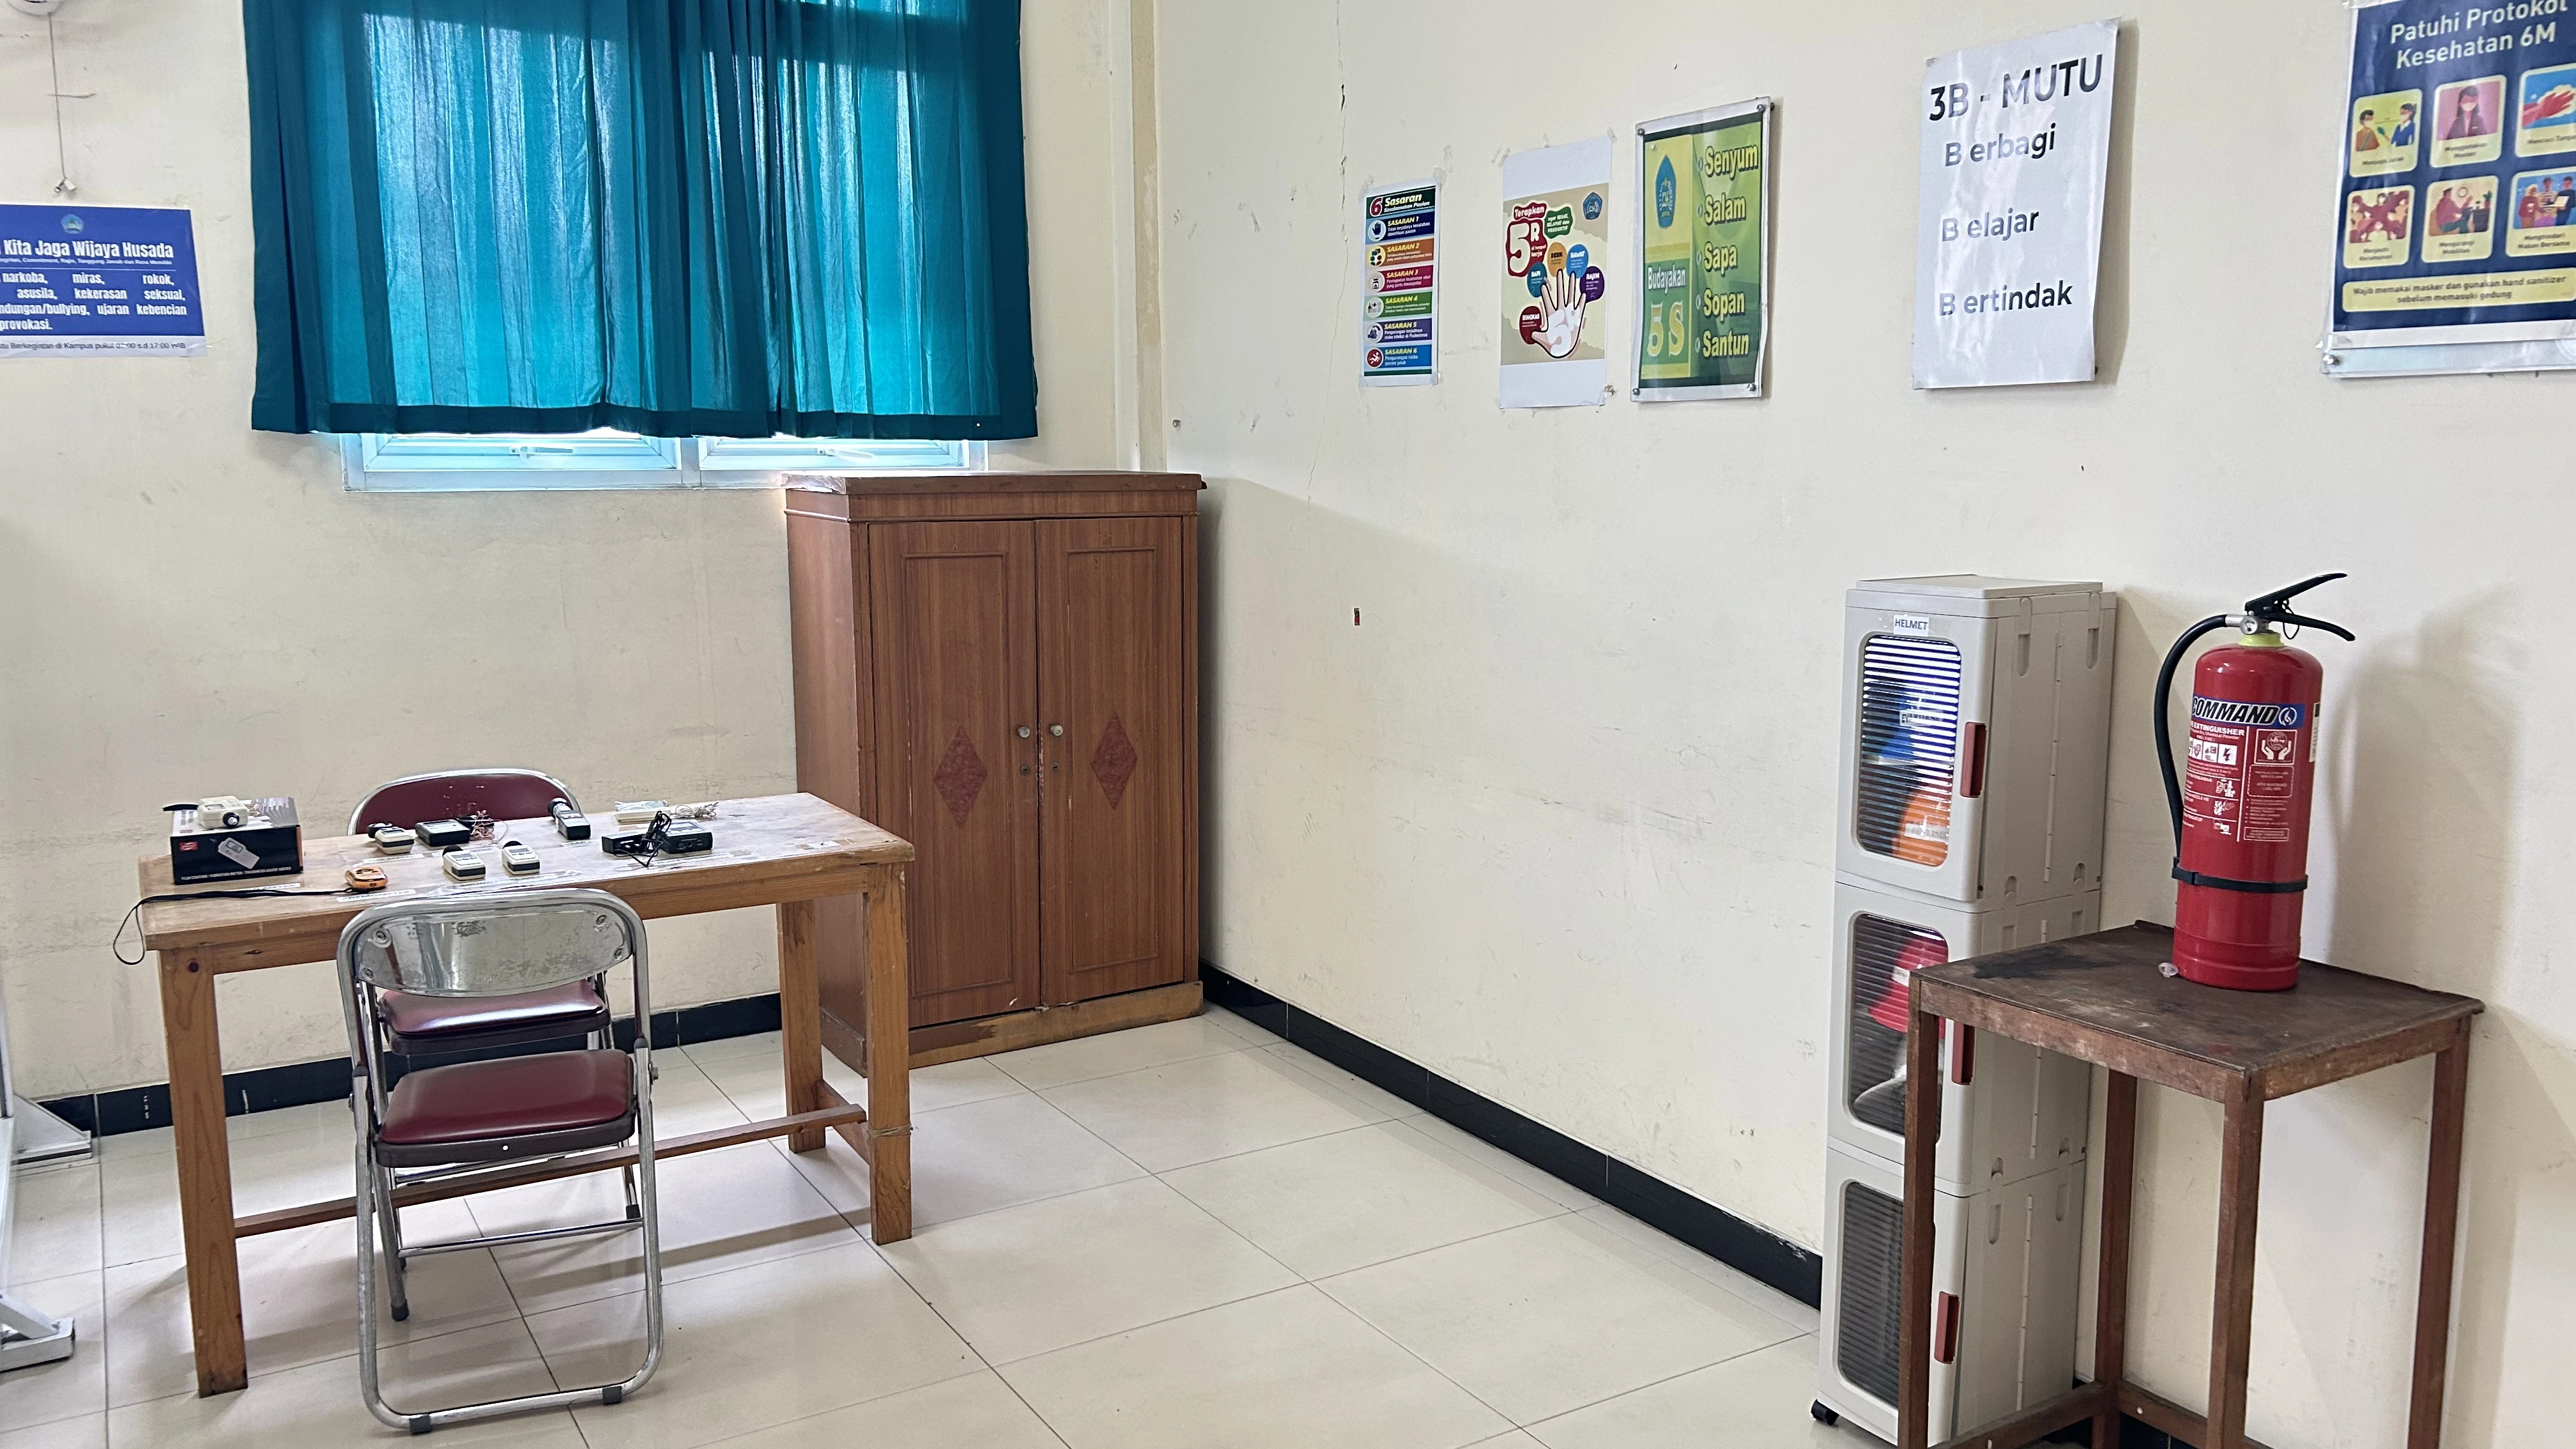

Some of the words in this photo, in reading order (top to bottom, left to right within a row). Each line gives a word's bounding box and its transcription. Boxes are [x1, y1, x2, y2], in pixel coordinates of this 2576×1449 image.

[2390, 12, 2460, 43] Patuhi
[2466, 0, 2568, 29] Protokol
[2396, 34, 2513, 69] Kesehatan
[2520, 22, 2556, 47] 6M
[1929, 82, 1968, 121] 3B
[2002, 54, 2103, 108] MUTU
[1705, 144, 1759, 180] Senyum
[1369, 196, 1383, 217] 6
[1384, 194, 1422, 207] Sasaran
[1514, 206, 1545, 218] Terapkan
[1704, 192, 1746, 226] Salam
[1387, 216, 1414, 227] SASARAN
[3, 239, 32, 256] Kita
[34, 240, 70, 257] Jaga
[72, 240, 119, 259] Wijaya
[122, 241, 174, 258] Husada
[1386, 243, 1414, 253] SASARAN
[1703, 241, 1738, 277] Sapa
[2, 272, 48, 284] narkoba,
[72, 272, 105, 285] miras,
[142, 273, 174, 286] rokok,
[1386, 269, 1414, 279] SASARAN
[1648, 264, 1686, 294] Budayakan
[2446, 282, 2462, 290] dan
[2502, 277, 2524, 286] hand
[2526, 275, 2567, 285] sanitizer
[17, 287, 57, 300] asusila,
[74, 288, 127, 300] kekerasan
[144, 288, 185, 301] seksual,
[1385, 295, 1413, 304] SASARAN
[96, 303, 129, 315] ujaran
[136, 303, 187, 315] kebencian
[1703, 288, 1745, 324] Sopan
[0, 318, 53, 331] provokasi.
[1702, 329, 1750, 359] Santun
[1894, 618, 1928, 631] HELMET
[2192, 696, 2280, 726] COMMAND
[2193, 722, 2245, 736] EXTINGUISHER
